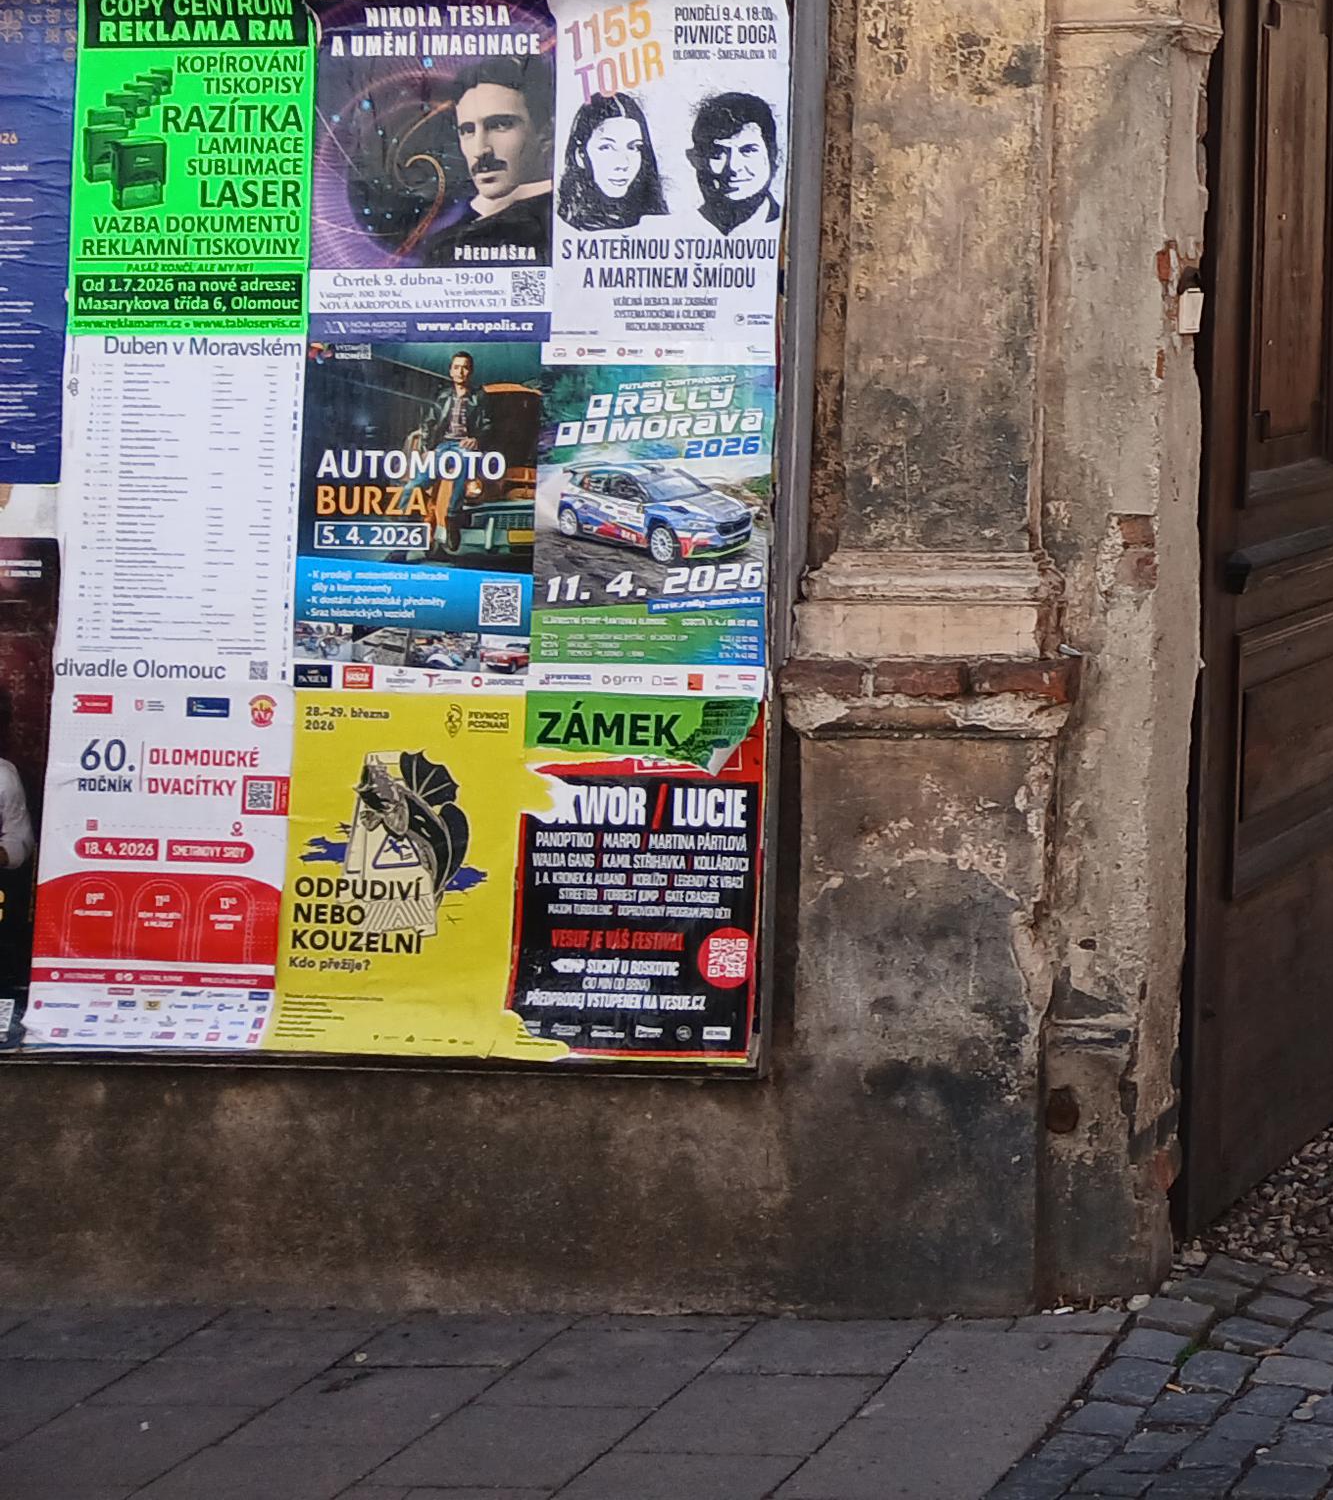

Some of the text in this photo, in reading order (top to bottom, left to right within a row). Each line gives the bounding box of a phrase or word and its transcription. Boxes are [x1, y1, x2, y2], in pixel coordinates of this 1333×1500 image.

[365, 5, 510, 27] NIKOLA TESLA
[674, 4, 721, 21] PONDĚLÍ
[99, 19, 294, 42] REKLAMA RM
[674, 25, 777, 44] PIVNICE DOGA
[331, 31, 541, 57] A UMĚNÍ IMAGINACE
[177, 51, 306, 73] KOPÍROVÁNÍ
[574, 41, 664, 105] TOUR
[203, 77, 304, 94] TISKOPISY
[162, 98, 303, 133] RAZÍTKA
[0, 133, 18, 144] 26
[198, 137, 304, 154] LAMINACE
[187, 158, 303, 175] SUBLIMACE
[200, 180, 301, 208] LASER
[94, 210, 300, 234] VAZBA DOKUMENTŮ
[82, 235, 300, 256] REKLAMNÍ TISKOVINY
[455, 245, 536, 260] PŘEDNÁŠKA
[562, 235, 776, 260] S KATEŘINOU STOJANOVOU
[197, 263, 215, 272] ALE
[583, 263, 756, 288] A MARTINEM ŠMÍDOU
[82, 278, 296, 292] Od 1.7.2026 na nové adrese:
[333, 273, 493, 287] Čtvrtek 9. dubna 19:00
[78, 297, 299, 316] Masarykova třída 6, Olomouc
[417, 319, 533, 334] www.akropolis.cz
[104, 336, 301, 356] Duben v Moravském
[684, 435, 761, 459] 2026
[316, 450, 506, 480] AUTOMOTO
[316, 485, 428, 516] BURZA
[322, 527, 423, 545] 5. 4. 2026
[547, 562, 764, 602] 11. 4. 2026
[55, 658, 226, 680] divadle Olomouc
[351, 707, 390, 719] března
[537, 700, 682, 747] ZÁMEK
[305, 720, 334, 730] 2026
[80, 738, 135, 772] 60.
[149, 747, 260, 768] OLOMOUCKÉ
[78, 776, 132, 793] ROČNÍK
[148, 774, 237, 796] DVACÍTKY
[673, 788, 747, 828] LUCIE
[85, 842, 154, 857] 18. 4. 2026
[649, 834, 695, 850] MARTINA
[295, 876, 423, 901] ODPUDIVÍ
[293, 903, 365, 925] NEBO
[291, 928, 427, 954] KOUZELNÍ
[289, 956, 371, 973] Kdo přežije?
